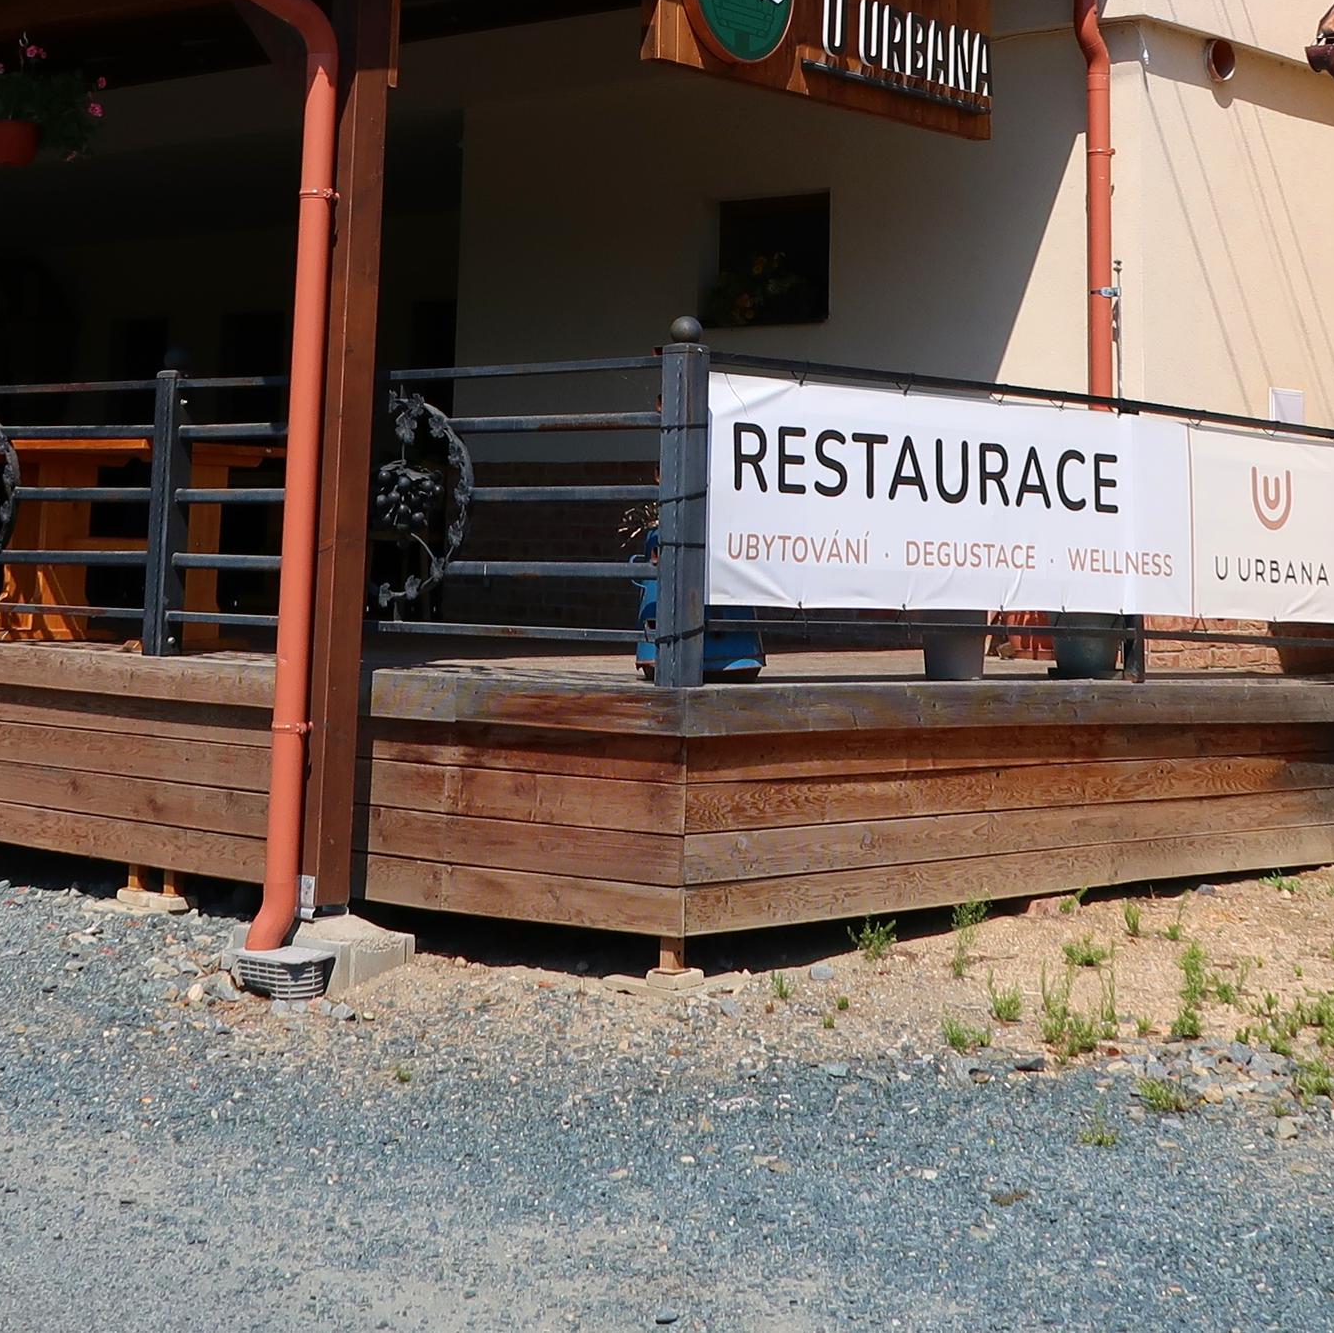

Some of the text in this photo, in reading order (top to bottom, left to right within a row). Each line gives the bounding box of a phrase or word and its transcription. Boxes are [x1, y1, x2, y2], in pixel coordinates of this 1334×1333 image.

[733, 421, 1119, 514] RESTAURACE
[728, 529, 1173, 577] UBYTOVÁNÍ DEGUSTACE WELLNESS
[1215, 556, 1329, 586] U URBANA
